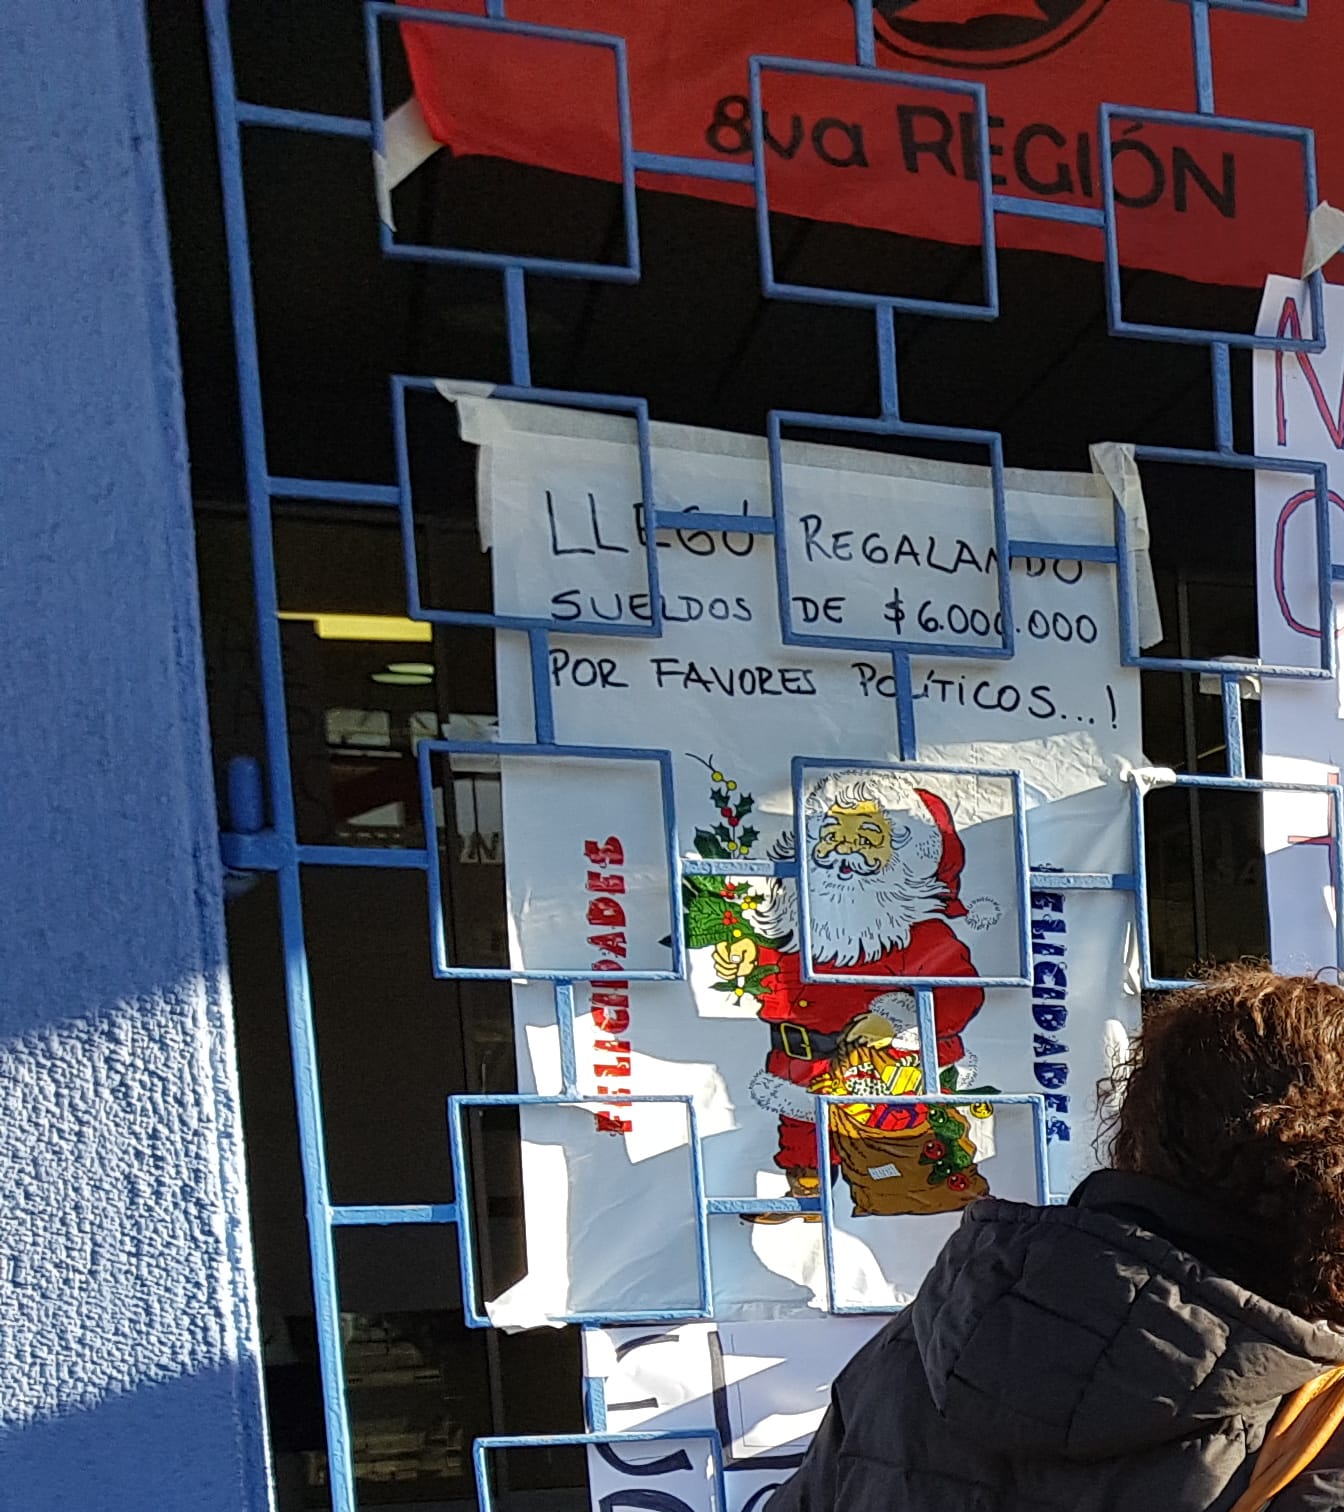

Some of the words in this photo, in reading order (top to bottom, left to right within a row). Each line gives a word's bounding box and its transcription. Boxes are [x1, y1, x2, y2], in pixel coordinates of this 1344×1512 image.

[706, 95, 869, 168] 8va
[896, 104, 1237, 219] REGIÓN
[550, 589, 753, 622] SUELDOS
[792, 596, 846, 623] DE
[550, 648, 629, 688] POR
[650, 658, 817, 697] FAVORES
[583, 835, 632, 1136] FELICIDADES
[1030, 865, 1072, 1143] ELICIDADES
